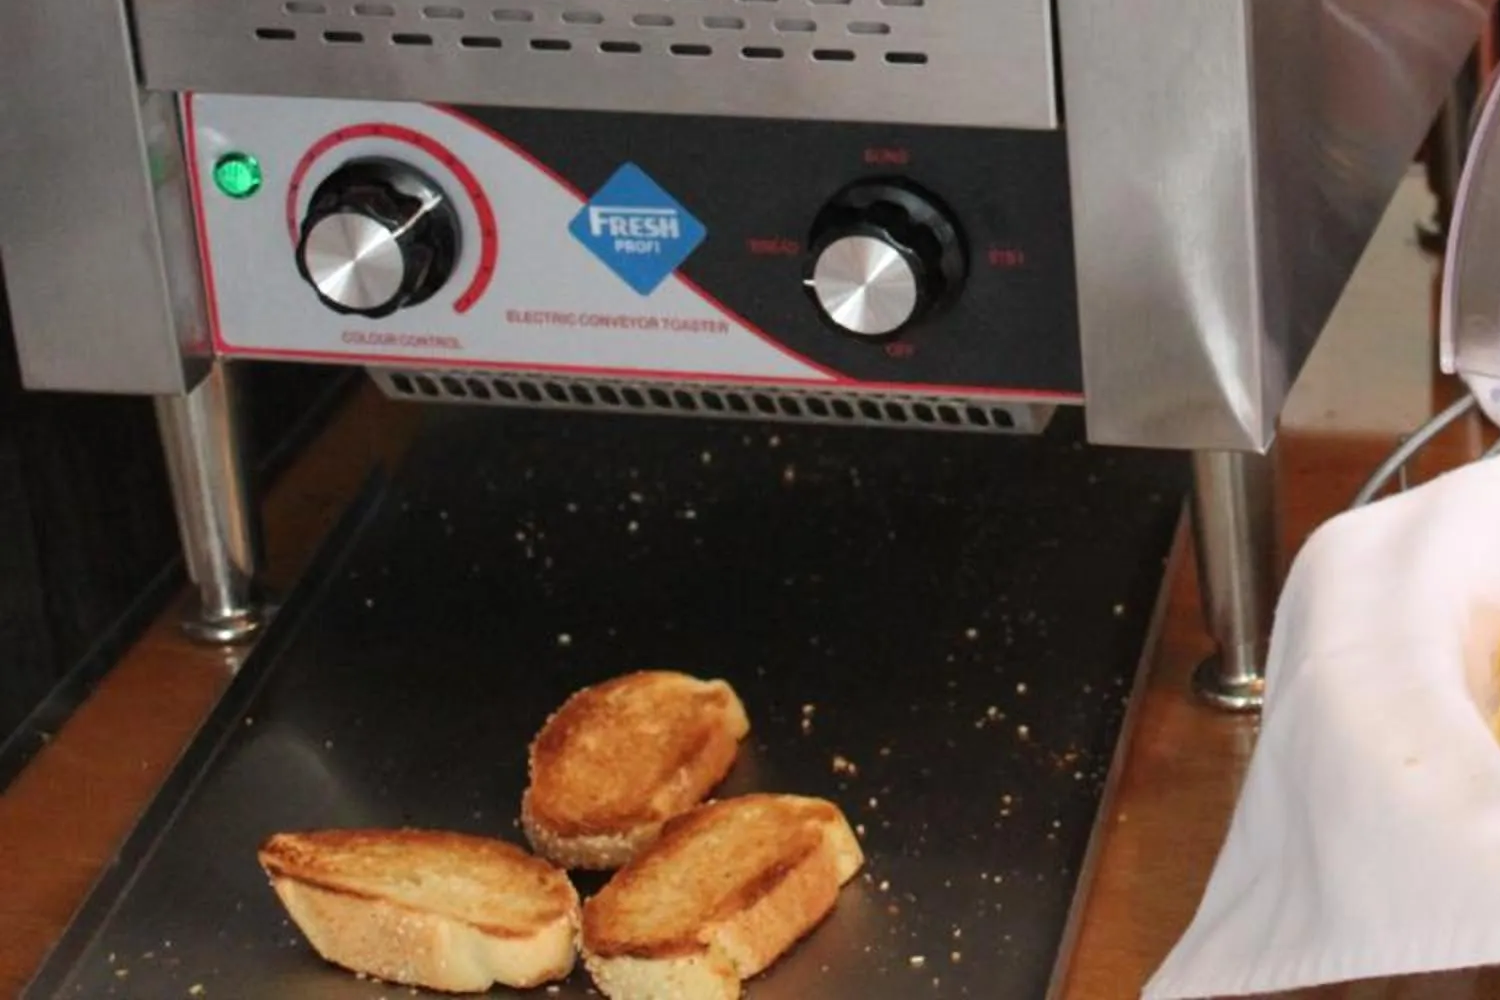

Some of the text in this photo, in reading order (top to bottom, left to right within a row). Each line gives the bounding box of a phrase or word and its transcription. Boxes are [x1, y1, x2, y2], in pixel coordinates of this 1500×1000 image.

[589, 205, 680, 239] FRESH
[614, 239, 661, 254] PROFI
[506, 310, 730, 333] ELECTRIC CONVEYOR TOASTER
[342, 331, 464, 349] COLOUR CONTROL
